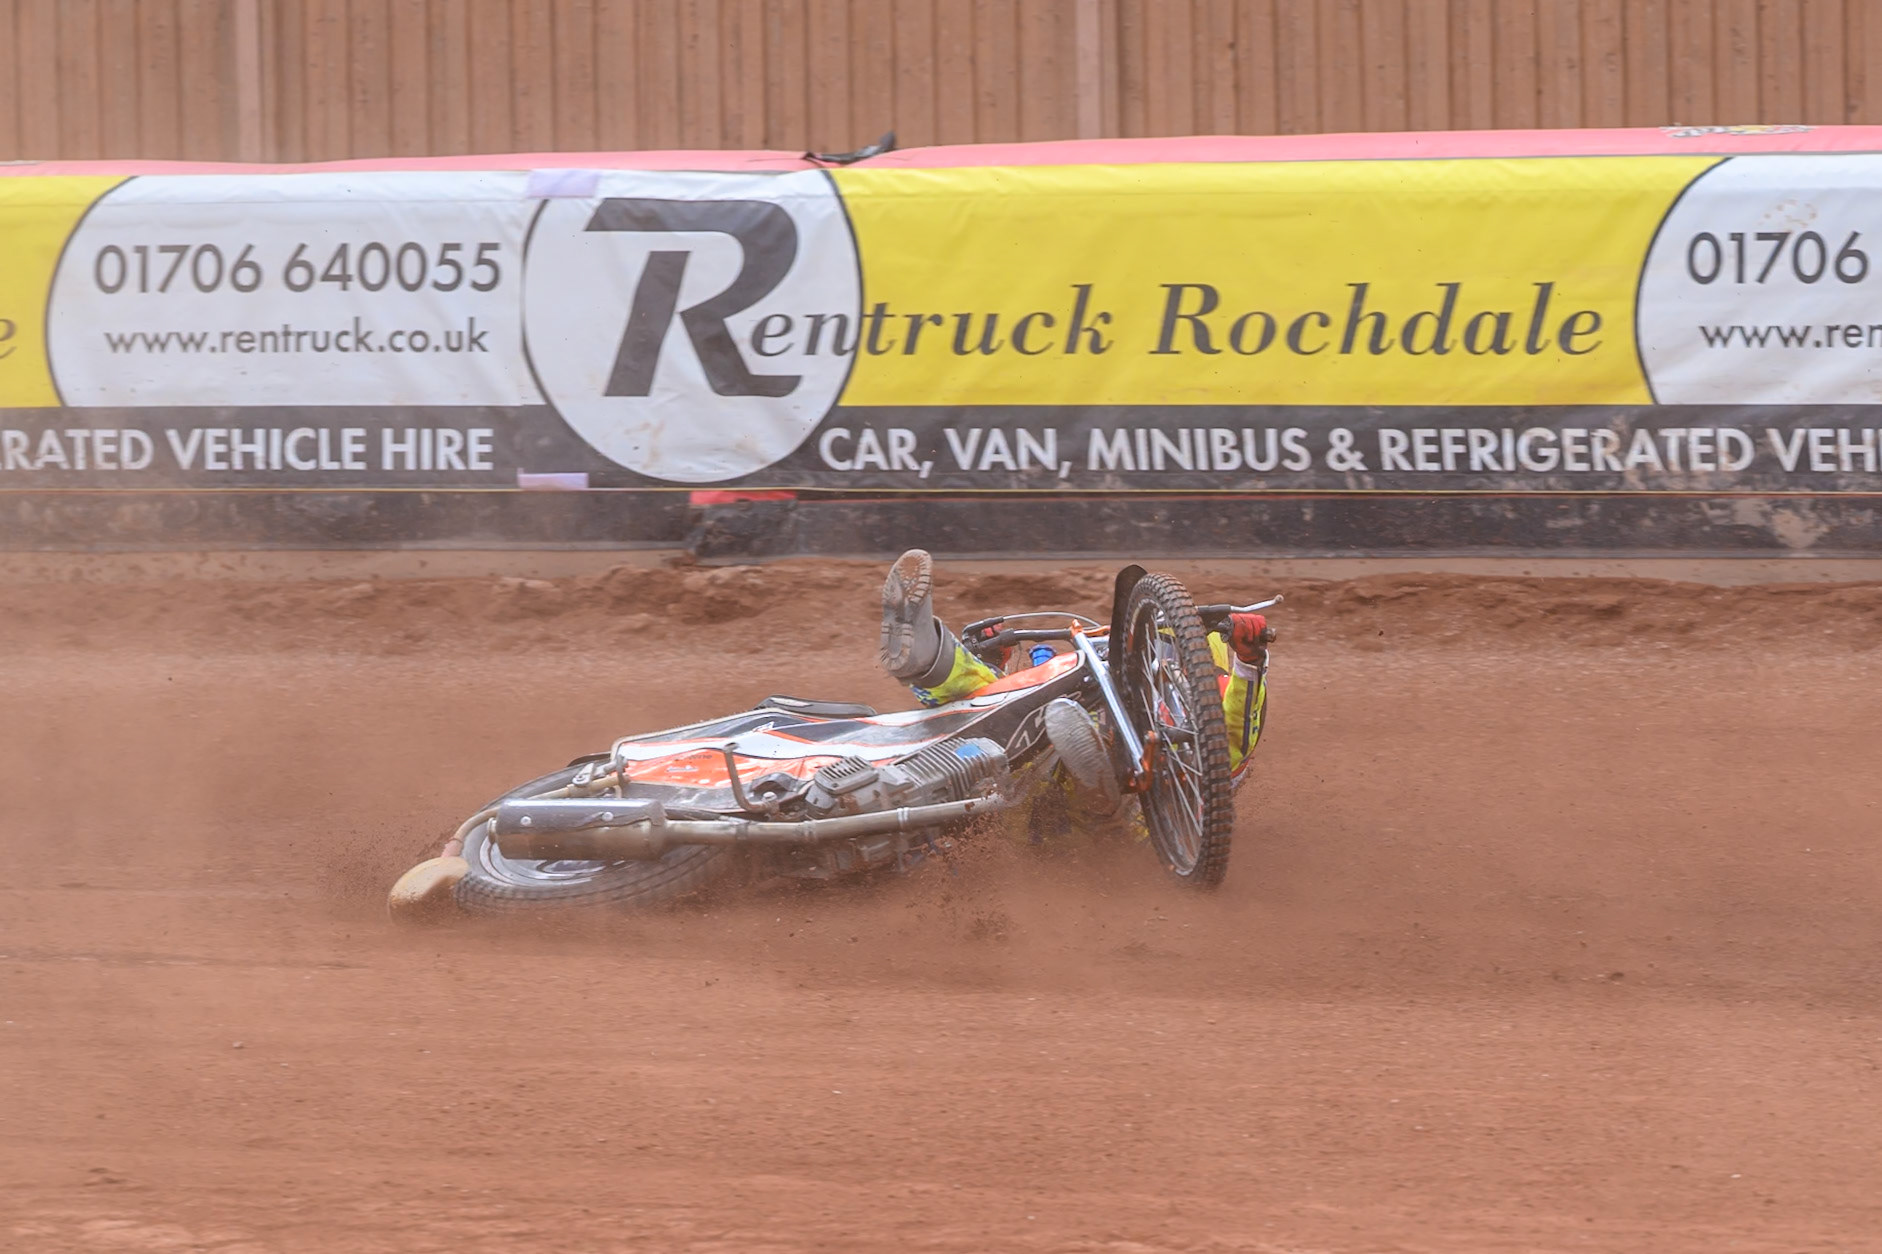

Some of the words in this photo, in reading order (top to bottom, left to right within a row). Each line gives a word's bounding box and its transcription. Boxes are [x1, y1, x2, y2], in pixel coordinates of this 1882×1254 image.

[94, 243, 262, 294] 01706
[283, 241, 501, 292] 640055
[1687, 231, 1869, 284] 01706
[584, 198, 1114, 398] Rentruck
[1147, 281, 1604, 356] Rochdale
[104, 316, 488, 354] www.rentruck.co.uk
[0, 428, 153, 471] RATED
[166, 427, 367, 471] VEHICLE
[382, 427, 493, 470] HIRE
[818, 427, 933, 479] CAR,
[944, 427, 1072, 479] VAN,
[1087, 427, 1310, 472] MINIBUS
[1325, 427, 1367, 472] &
[1380, 427, 1755, 473] REFRIGERATED
[1765, 427, 1882, 473] VEH
